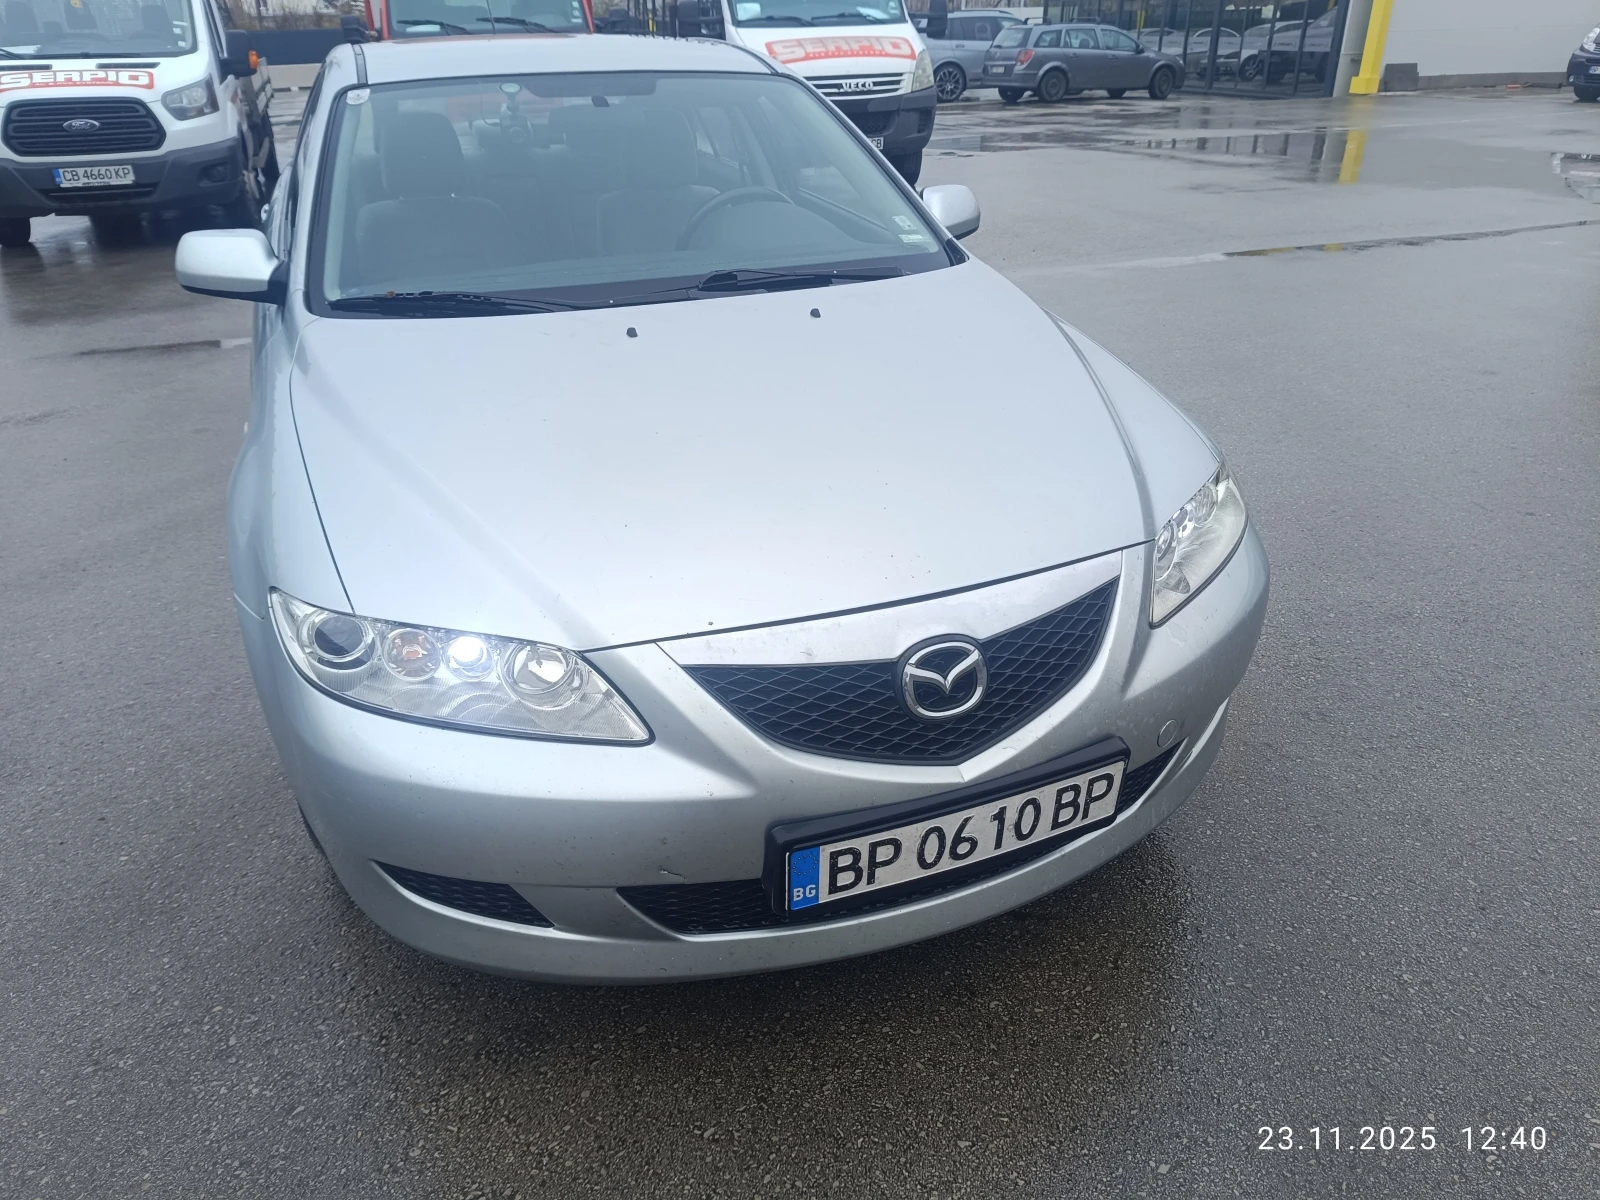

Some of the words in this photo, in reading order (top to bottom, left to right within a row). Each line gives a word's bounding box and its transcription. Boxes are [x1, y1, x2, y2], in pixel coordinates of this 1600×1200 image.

[771, 36, 913, 60] SERPIO
[0, 70, 150, 88] SERPIO
[62, 169, 80, 182] CB
[82, 168, 112, 181] 4660
[113, 167, 131, 180] KP
[828, 837, 902, 895] BP
[916, 797, 1042, 870] 0610
[1050, 772, 1115, 831] BP
[793, 884, 817, 902] BG
